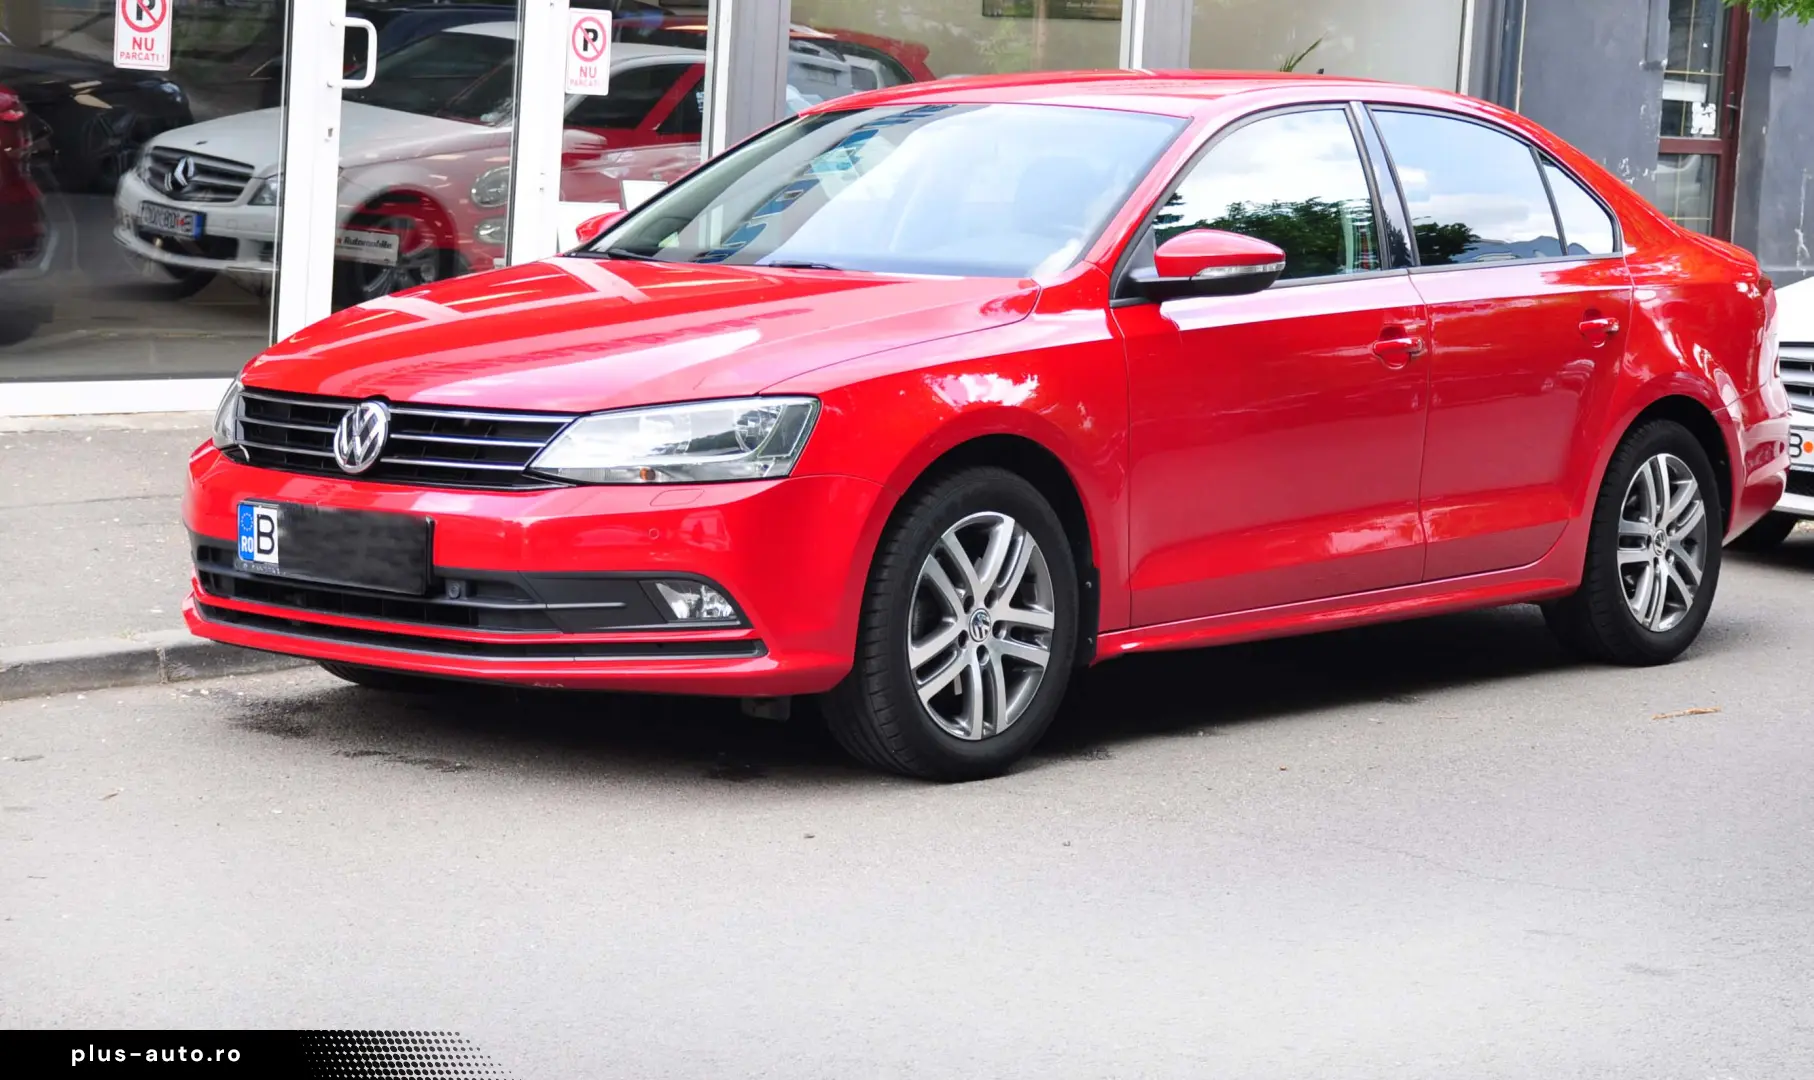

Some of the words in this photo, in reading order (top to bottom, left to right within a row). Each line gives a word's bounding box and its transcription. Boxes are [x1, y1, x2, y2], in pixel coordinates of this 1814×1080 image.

[132, 36, 155, 51] NU
[580, 66, 597, 79] NU
[256, 513, 275, 555] B
[241, 535, 254, 553] RO
